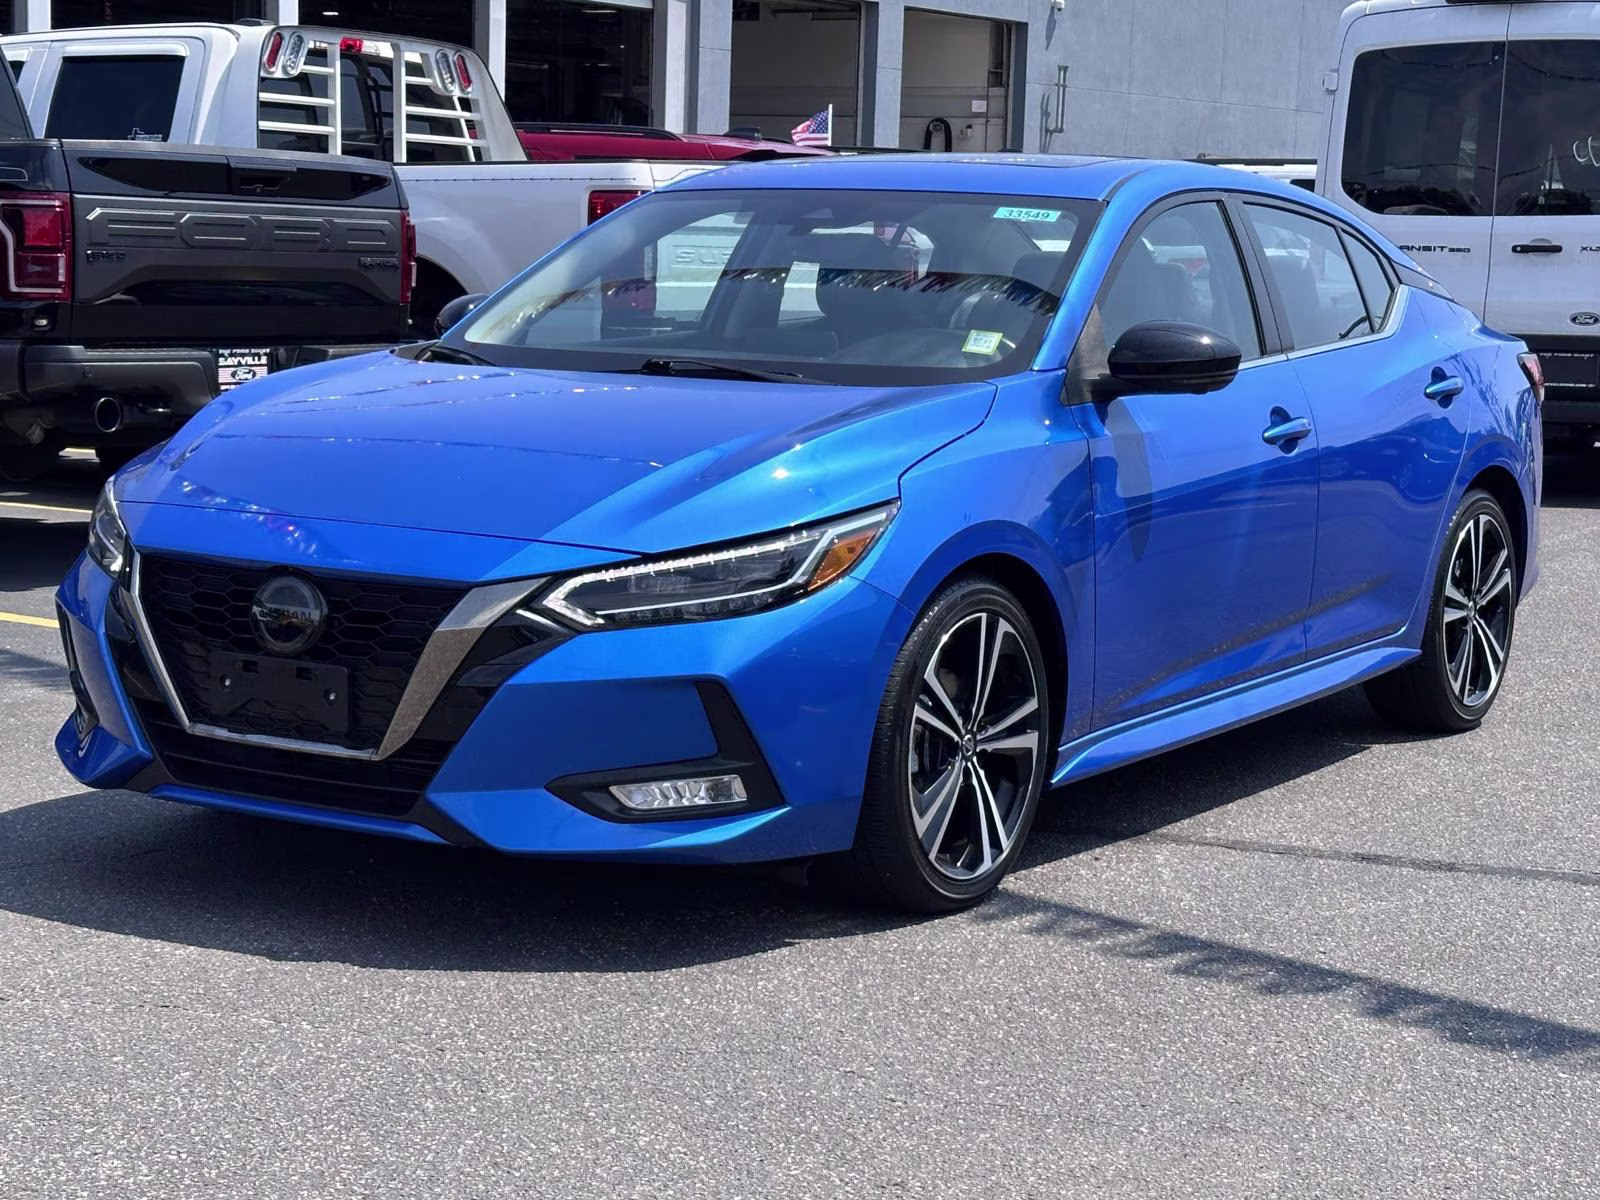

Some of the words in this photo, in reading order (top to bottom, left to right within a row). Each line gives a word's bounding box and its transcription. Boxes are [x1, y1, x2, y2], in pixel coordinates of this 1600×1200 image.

[1004, 209, 1050, 220] 33549
[86, 206, 397, 253] FORD
[218, 355, 268, 366] SAYVILLE
[234, 369, 254, 380] Ford
